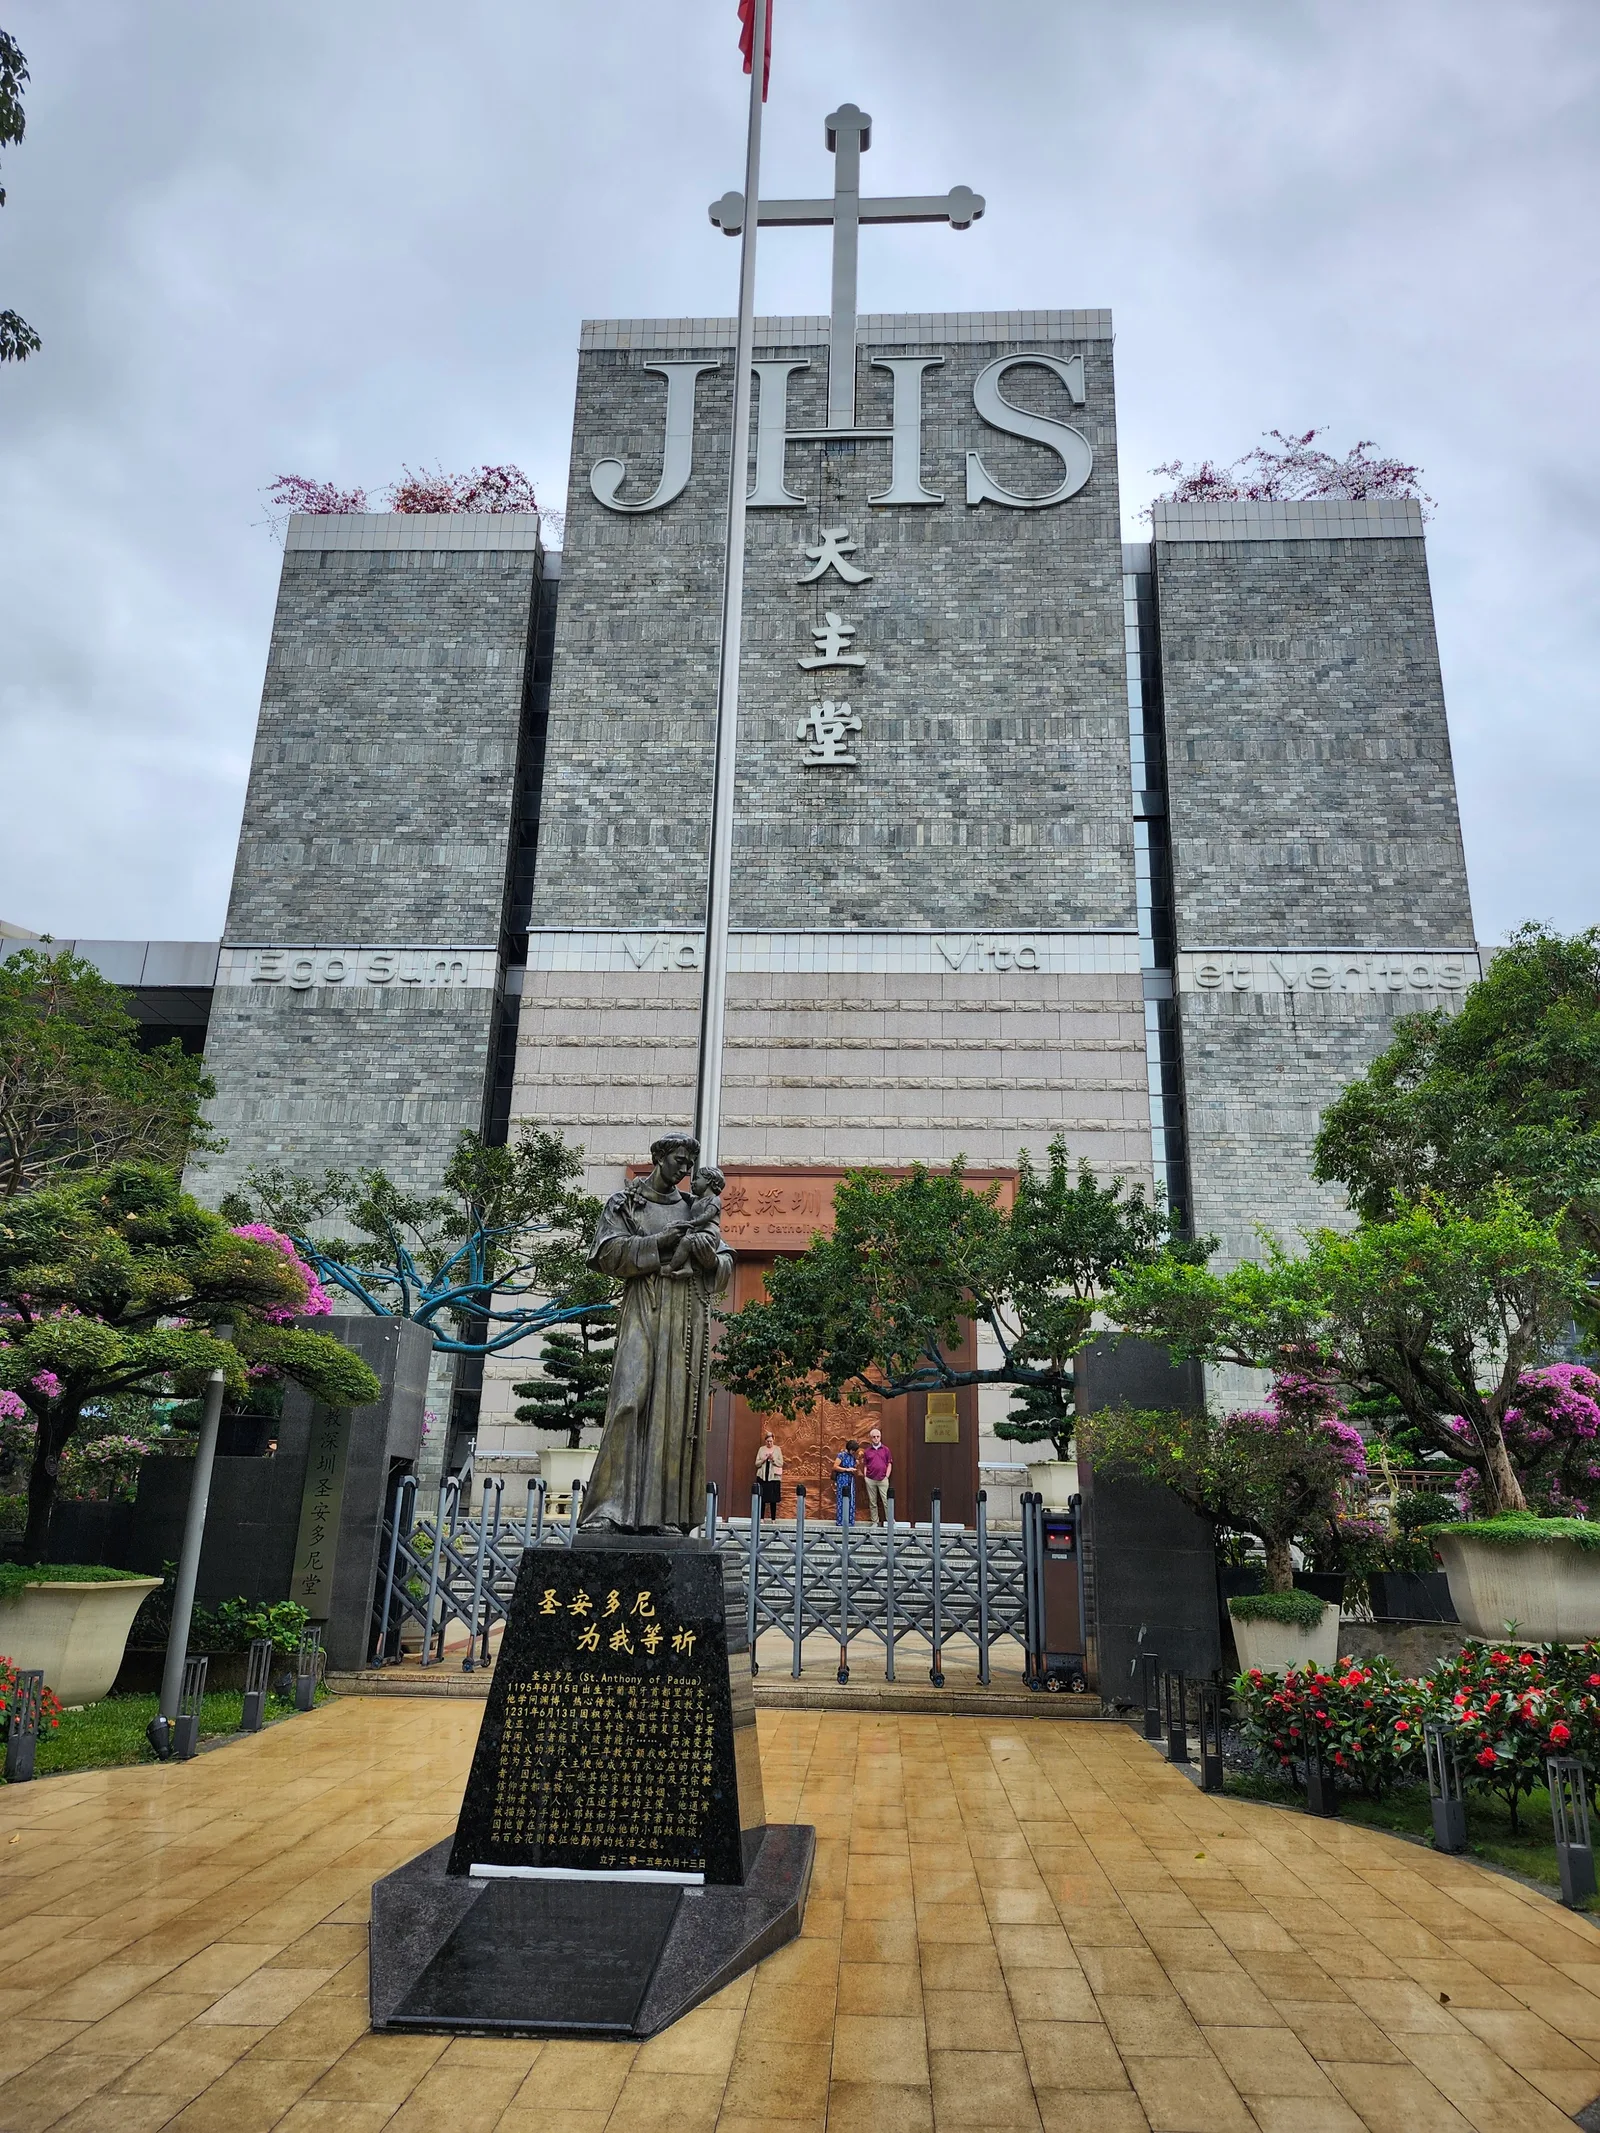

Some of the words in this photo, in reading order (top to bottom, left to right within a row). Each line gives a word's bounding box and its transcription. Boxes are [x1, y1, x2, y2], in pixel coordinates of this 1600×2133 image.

[590, 352, 1093, 513] JHS
[796, 527, 873, 767] 天主堂
[622, 936, 700, 969] Via
[936, 938, 1040, 971] Vita
[251, 951, 348, 989] Ego
[365, 952, 468, 982] Sum
[1194, 958, 1250, 990] et
[1269, 954, 1464, 990] Veritas
[721, 1185, 820, 1217] 教深圳
[302, 1408, 341, 1595] 教深圳圣安多尼堂
[538, 1588, 655, 1617] 圣安多尼
[576, 1622, 697, 1656] 为我等祈
[649, 1675, 661, 1684] of
